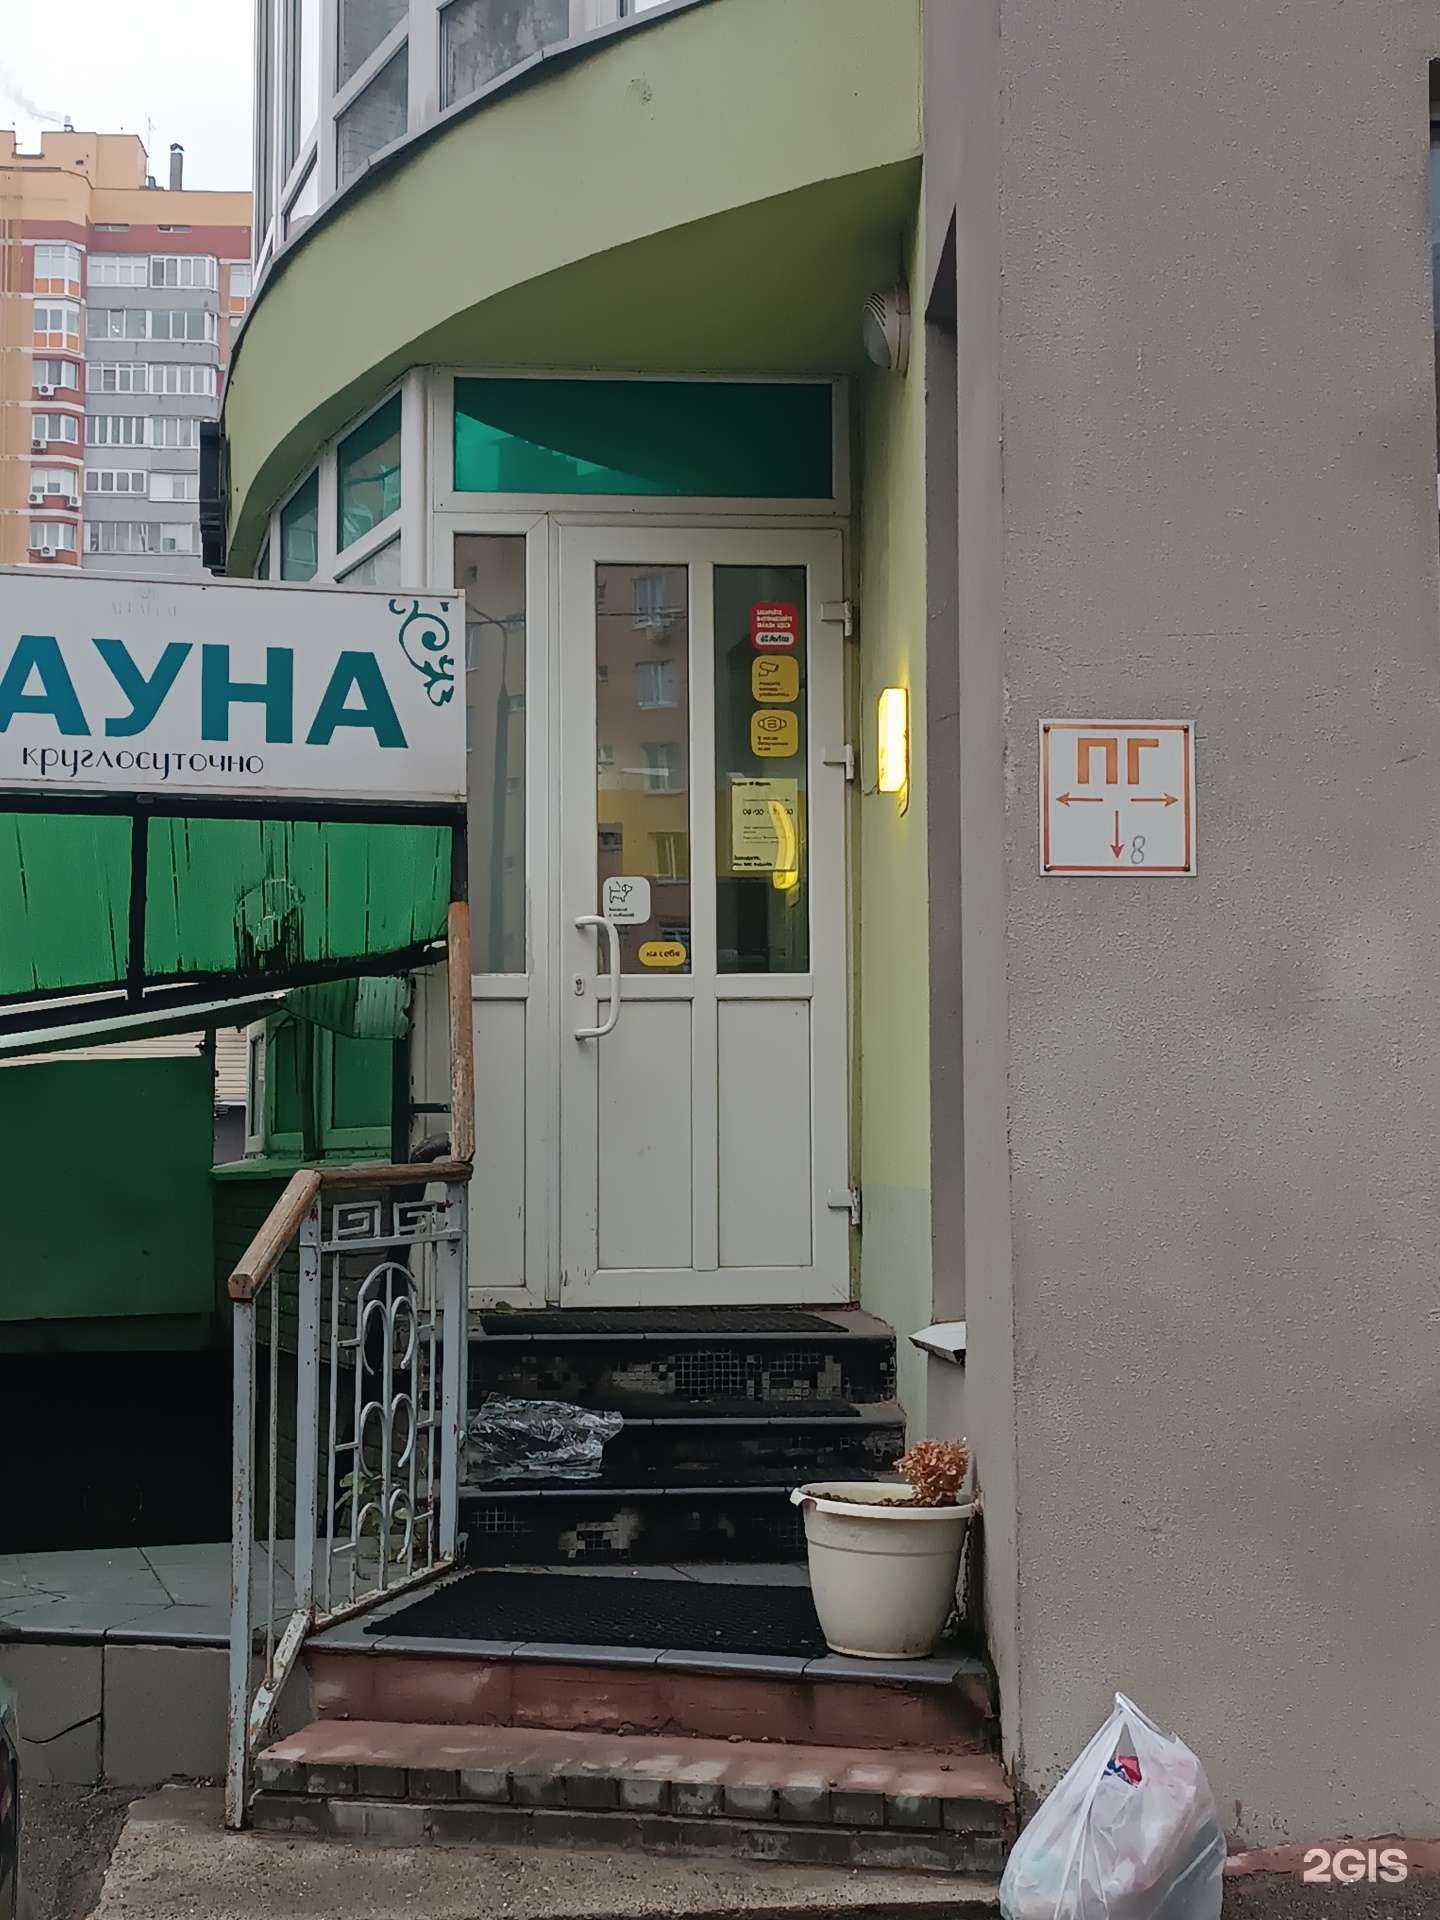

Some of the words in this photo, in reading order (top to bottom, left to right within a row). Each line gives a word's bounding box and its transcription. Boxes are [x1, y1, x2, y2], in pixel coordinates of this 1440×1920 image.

[0, 634, 409, 749] АУНА
[22, 745, 264, 780] круглосуточно
[1077, 737, 1160, 785] ПГ
[1130, 834, 1146, 865] 8
